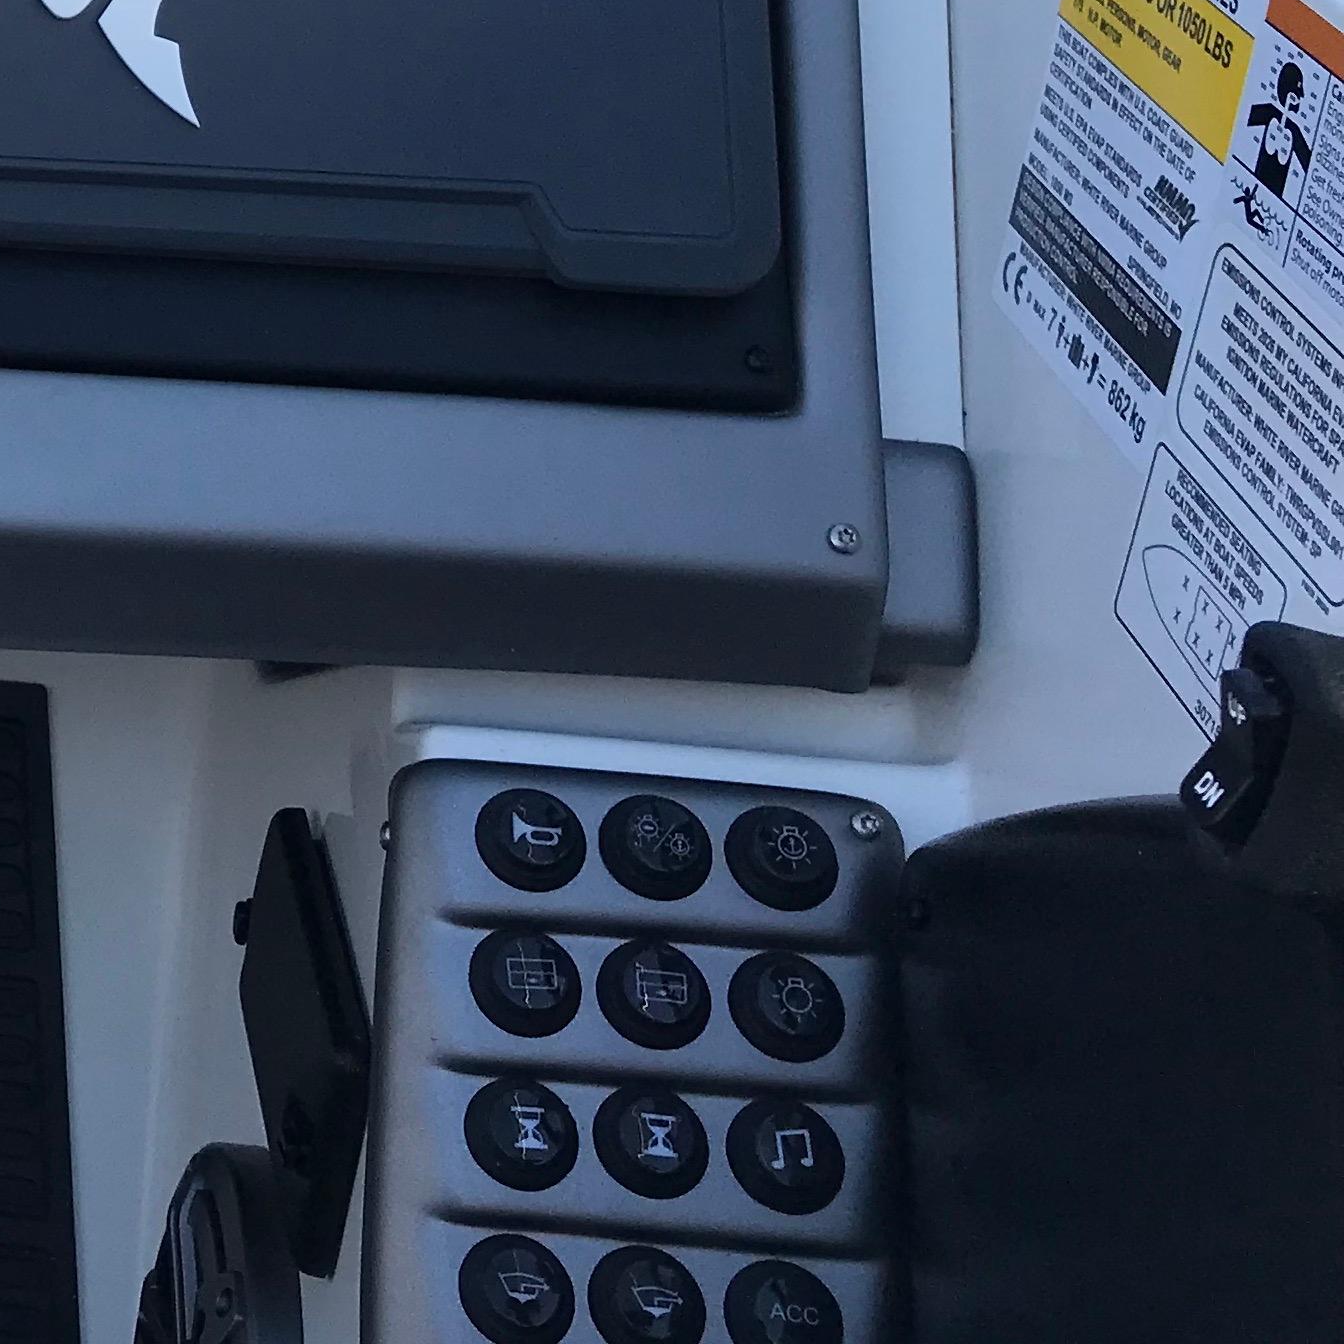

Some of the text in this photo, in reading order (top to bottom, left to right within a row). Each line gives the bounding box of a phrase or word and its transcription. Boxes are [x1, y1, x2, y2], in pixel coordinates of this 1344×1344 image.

[1162, 46, 1182, 73] GEAR
[1177, 1, 1206, 45] 1050
[1204, 24, 1233, 68] LBS
[1050, 61, 1092, 110] CERTIFICATION
[1054, 43, 1077, 71] SAFETY
[1076, 64, 1112, 106] STANDARDS
[1118, 103, 1143, 134] EFFECT
[1142, 126, 1153, 145] ON
[1154, 135, 1167, 158] THE
[1166, 148, 1185, 176] DATE
[1184, 166, 1196, 184] OF
[1071, 37, 1089, 61] BOAT
[1088, 53, 1119, 90] COMPLIES
[1118, 81, 1134, 102] WITH
[1147, 107, 1170, 136] COAST
[1170, 128, 1194, 159] GUARD
[1040, 104, 1130, 199] USING CERTIFIED COMPONENTS
[1044, 84, 1064, 111] MEETS
[1075, 113, 1088, 135] EPA
[1087, 126, 1105, 149] EVAP
[1104, 142, 1142, 187] STANDARDS
[1311, 168, 1326, 190] Get
[1315, 151, 1344, 185] dizzine
[1081, 176, 1102, 204] WHITE
[1100, 195, 1119, 223] RIVER
[1119, 214, 1144, 249] MARINE
[1143, 240, 1167, 270] GROUP
[1143, 186, 1183, 232] CERTIFIED
[1306, 185, 1322, 208] See
[1091, 267, 1135, 321] RESPONSIBLE
[1290, 247, 1344, 307] Shut off moto
[1295, 229, 1332, 274] Rotating
[1066, 293, 1086, 323] WHITE
[1085, 315, 1104, 343] RIVER
[1103, 335, 1128, 371] MARINE
[1127, 362, 1151, 395] GROUP
[1170, 299, 1182, 320] MO
[1221, 257, 1332, 378] EMISSIONS CONTROL SYSTEMS
[1047, 306, 1058, 331] 7
[1108, 379, 1131, 422] 862
[1129, 402, 1146, 444] kg
[1221, 315, 1344, 457] EMISSIONS REGULATIONS FOR SPA
[1233, 302, 1259, 337] MEETS
[1287, 358, 1332, 415] CALIFORNIA
[1194, 384, 1285, 493] CALIFORNIA EVAP FAMILY:
[1195, 350, 1253, 422] MANUFACTURER:
[1254, 413, 1278, 449] WHITE
[1277, 439, 1301, 475] RIVER
[1300, 464, 1332, 508] MARINE
[1226, 346, 1339, 474] IGNITION MARINE WATERCRAFT
[1176, 469, 1262, 576] RECOMMENDED SEATING
[1203, 419, 1242, 470] EMISSIONS
[1241, 462, 1275, 511] CONTROL
[1309, 540, 1322, 559] SP
[1164, 480, 1264, 605] LOCATIONS AT BOAT SPEEDS
[1171, 513, 1204, 560] GREATER
[1204, 550, 1224, 584] THAN
[1228, 581, 1246, 610] MPH
[1194, 771, 1225, 808] DN
[769, 1301, 820, 1326] ACC
